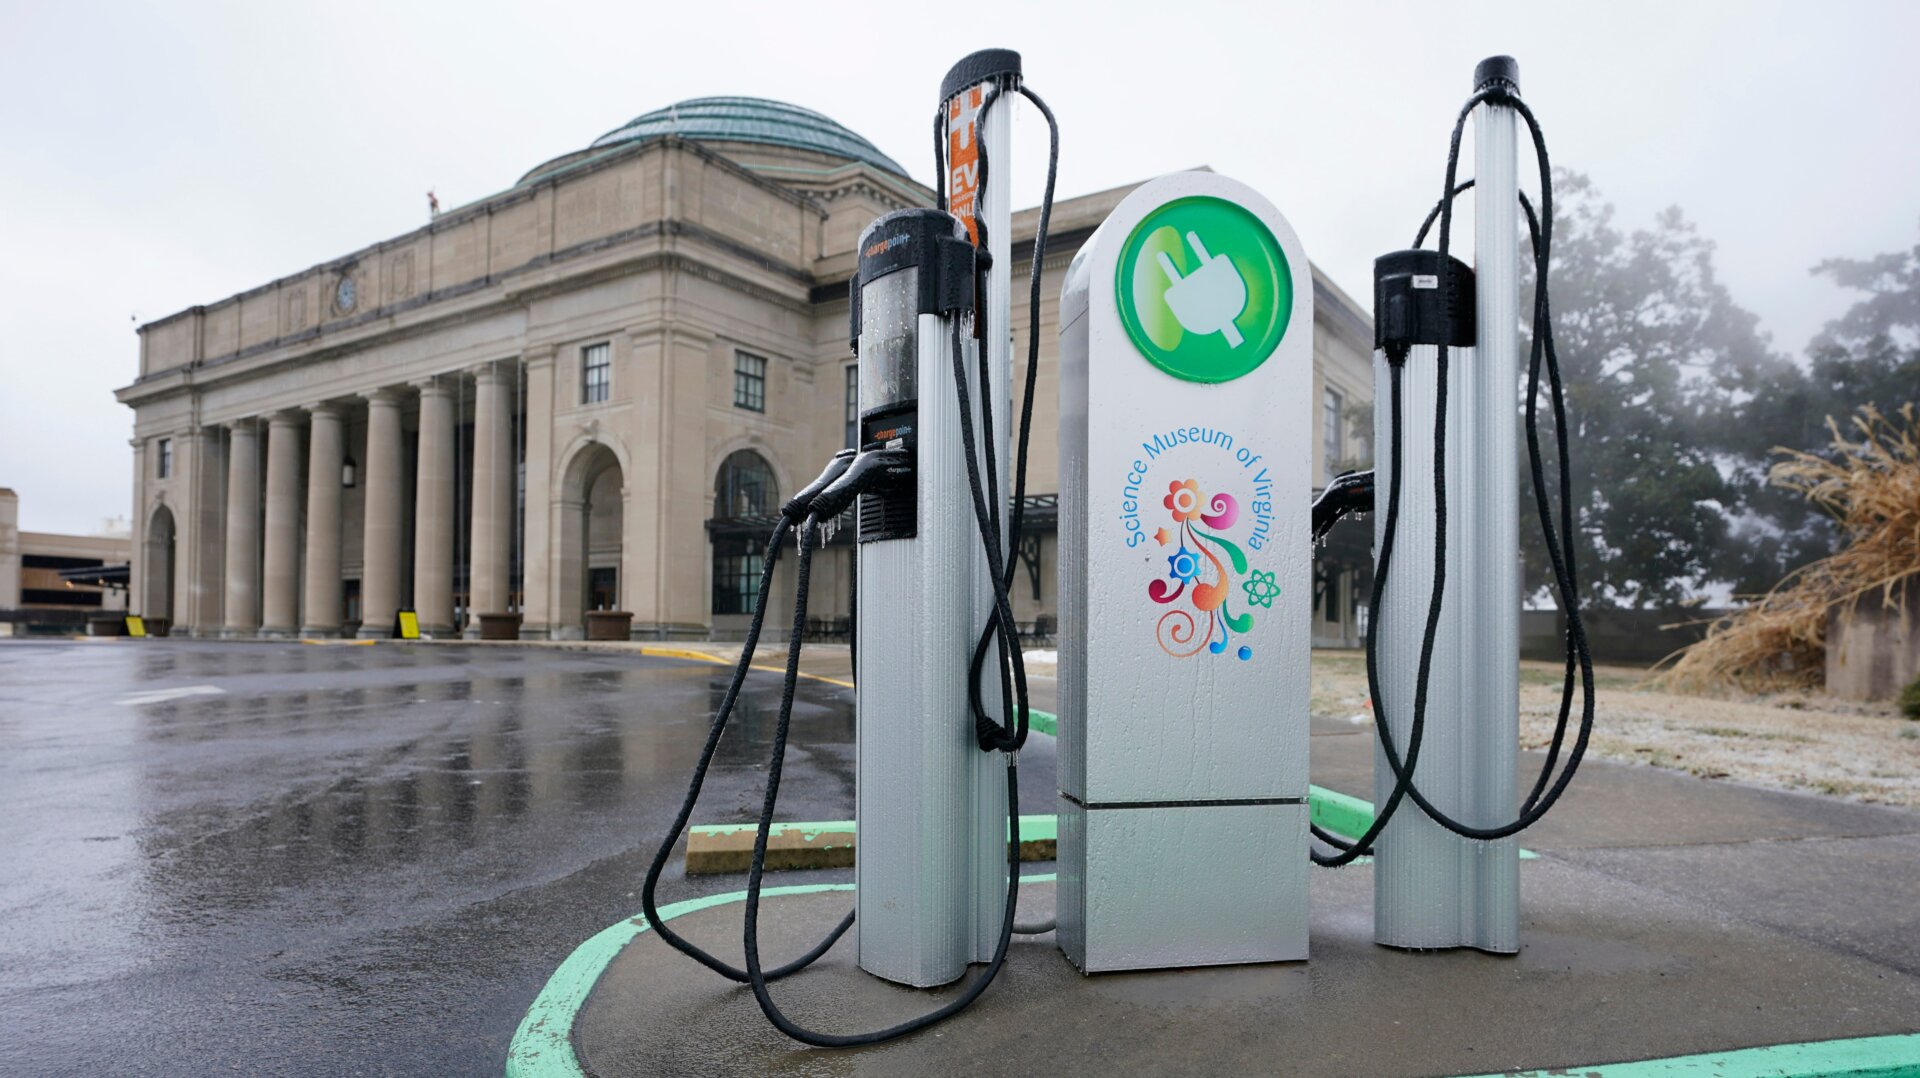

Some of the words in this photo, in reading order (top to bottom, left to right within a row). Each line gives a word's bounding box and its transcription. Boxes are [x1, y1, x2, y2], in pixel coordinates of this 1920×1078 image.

[951, 160, 979, 195] EV
[951, 202, 975, 219] ONL
[1142, 426, 1234, 460] Museum
[1236, 447, 1262, 468] of
[1119, 459, 1148, 548] Science
[1248, 467, 1276, 550] Virginia
